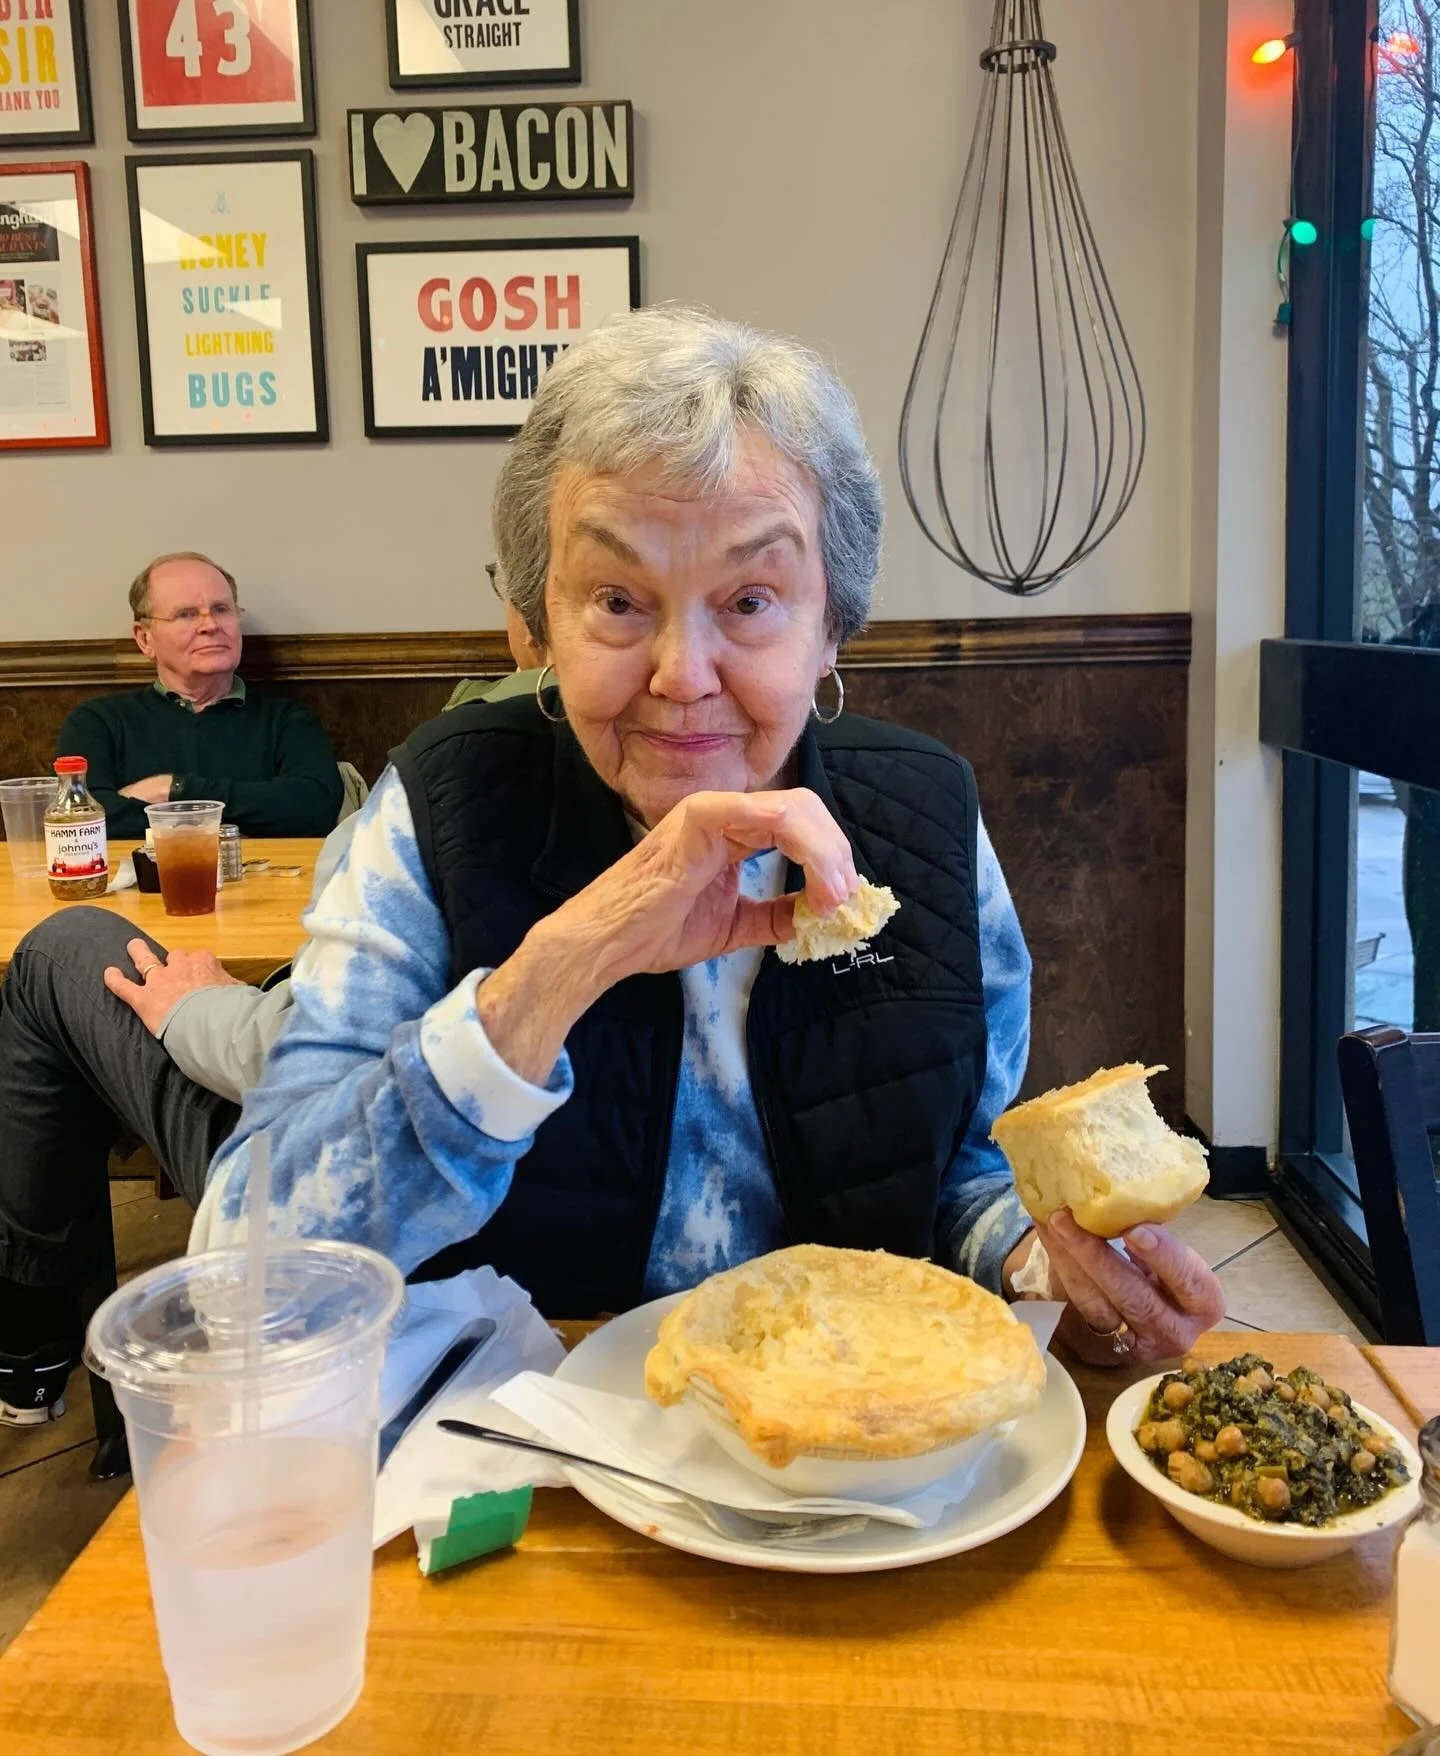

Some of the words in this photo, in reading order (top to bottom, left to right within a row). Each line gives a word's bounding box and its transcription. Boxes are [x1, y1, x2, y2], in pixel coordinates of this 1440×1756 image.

[166, 0, 252, 77] 43
[443, 22, 522, 48] STRAIGHT
[36, 88, 60, 110] YOU
[351, 113, 367, 195] I
[442, 105, 629, 192] BACON
[178, 231, 267, 270] ONEY
[417, 275, 581, 333] GOSH
[185, 331, 274, 356] LIGHTNING
[188, 371, 278, 408] BUGS
[422, 344, 570, 402] A'MIGHT
[51, 829, 77, 838] HAMM
